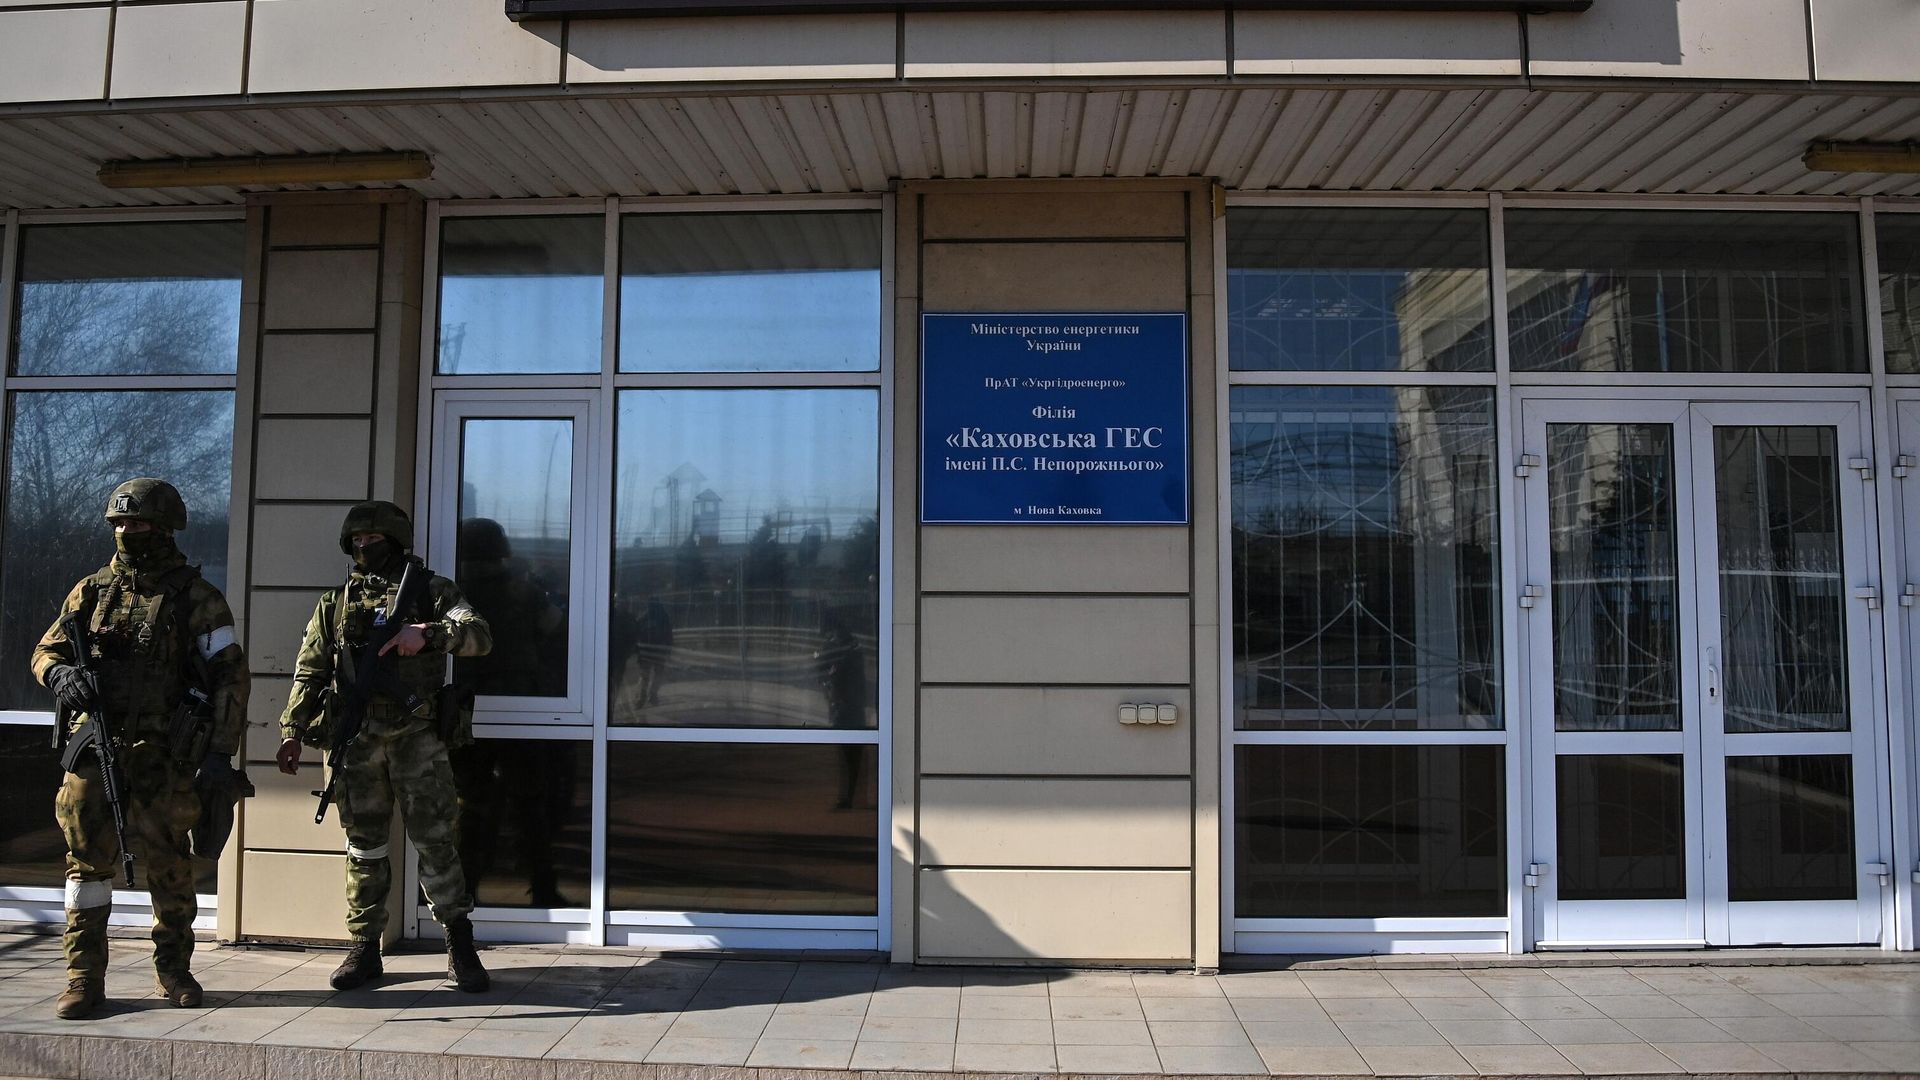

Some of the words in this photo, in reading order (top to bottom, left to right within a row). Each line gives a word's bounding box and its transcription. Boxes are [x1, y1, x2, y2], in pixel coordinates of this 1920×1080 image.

[971, 323, 1060, 336] Міністерство
[1063, 326, 1140, 336] енергетики
[1026, 339, 1081, 354] України
[985, 377, 1018, 389] ПрАТ
[1021, 377, 1126, 389] «Укргідроенерго»
[1031, 405, 1076, 419] Філія
[945, 427, 1097, 449] «Каховська
[1105, 427, 1163, 449] ГЕС
[945, 456, 986, 471] імені
[992, 456, 1027, 471] П.С.
[1033, 456, 1164, 475] Непорожнього»
[1028, 505, 1055, 515] Нова
[1058, 505, 1102, 515] Каховка
[374, 607, 387, 622] Z
